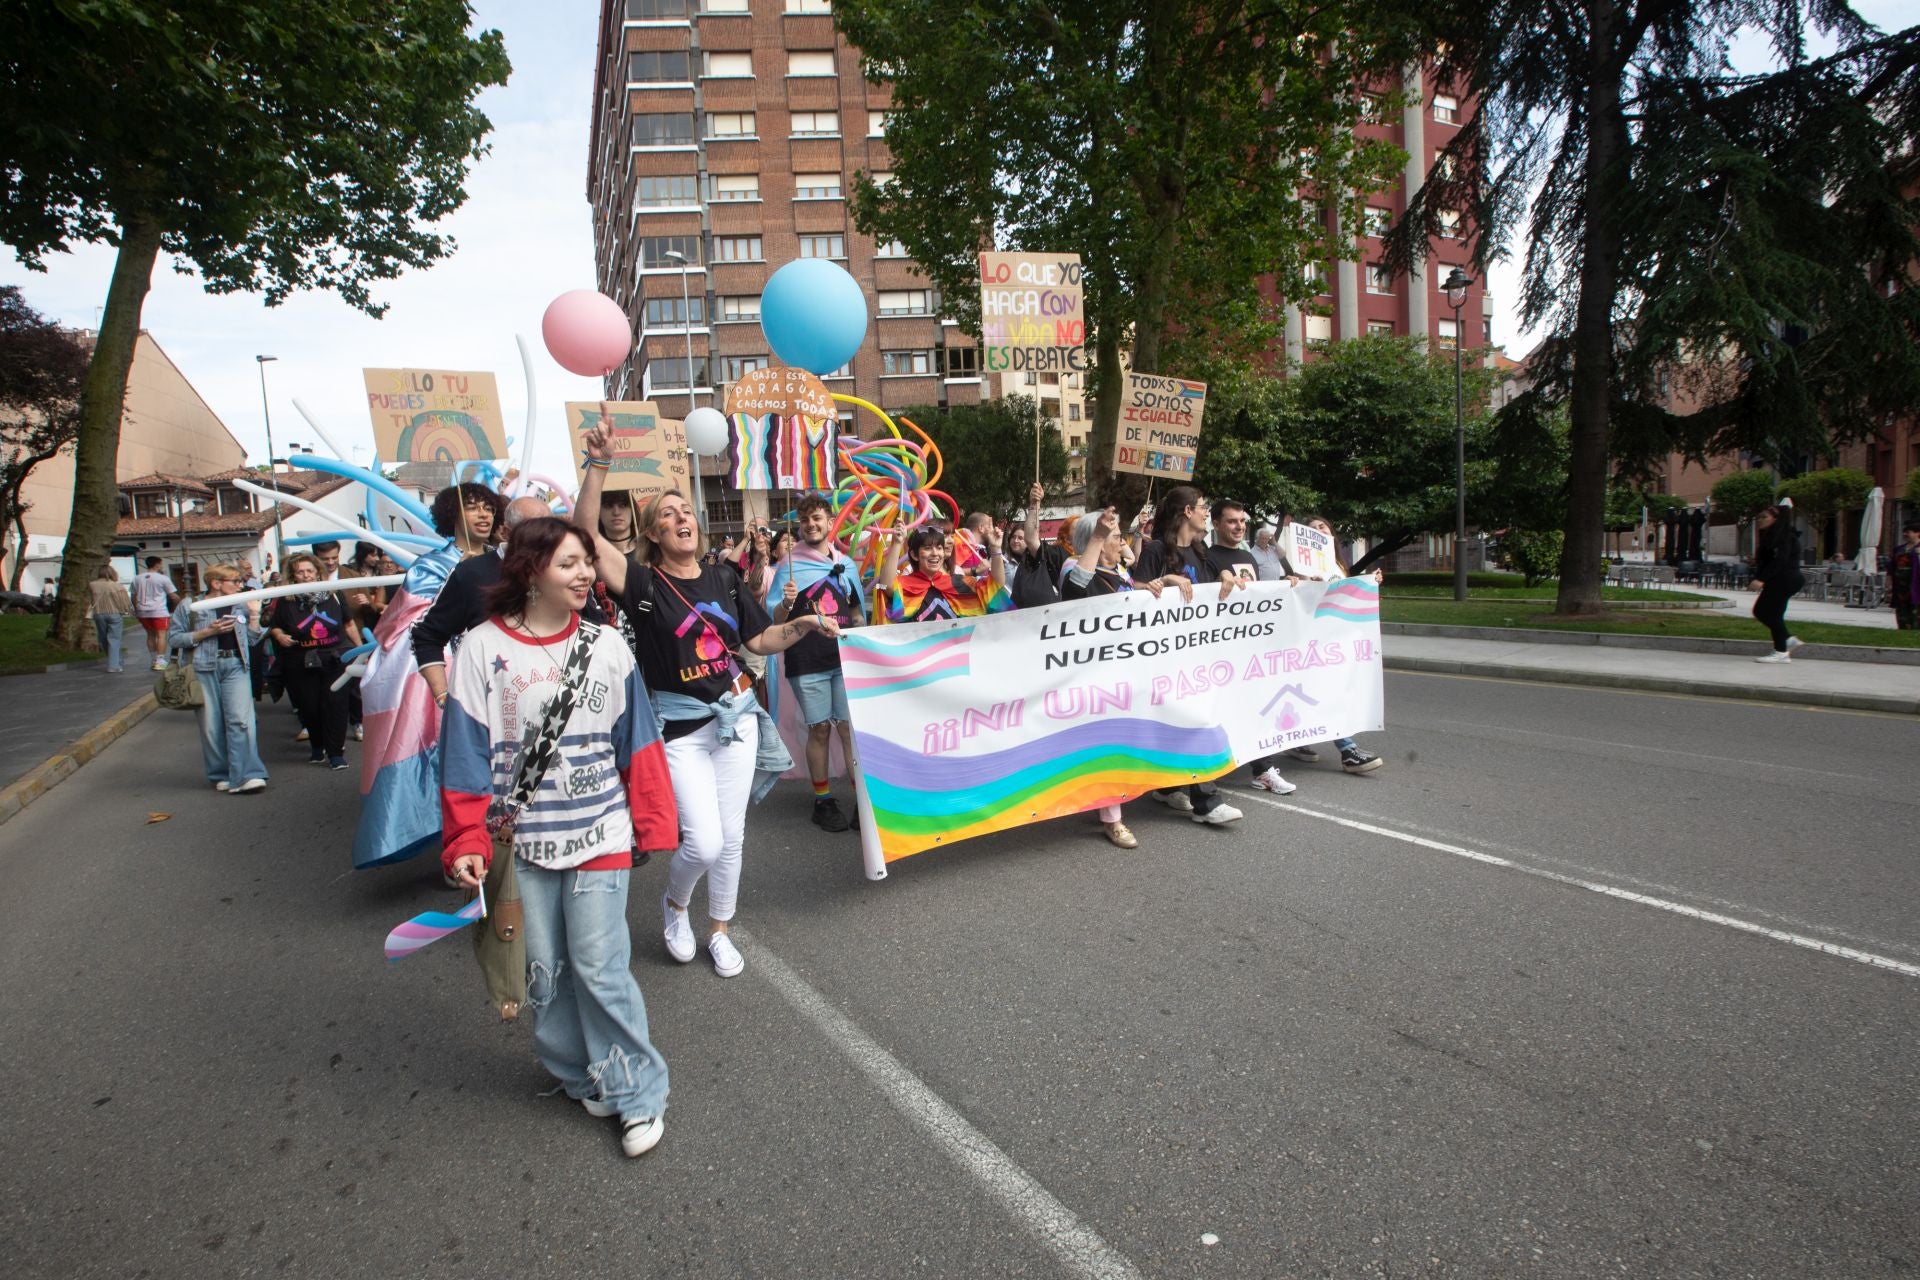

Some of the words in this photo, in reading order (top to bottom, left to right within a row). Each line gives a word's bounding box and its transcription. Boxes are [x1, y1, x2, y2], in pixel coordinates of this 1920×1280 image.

[1016, 262, 1057, 286] QUE
[1057, 262, 1081, 286] YO
[984, 290, 1040, 316] HAGA
[1040, 290, 1076, 315] CON
[1056, 319, 1084, 346] NO
[988, 346, 1010, 371] ES
[1012, 345, 1084, 371] DEBATE
[384, 372, 434, 393] SOLO
[442, 374, 469, 394] TU
[752, 371, 777, 381] BAJO
[786, 372, 807, 381] ESTE
[1129, 374, 1175, 393] TODXS
[368, 392, 425, 410] PUEDES
[735, 382, 825, 405] PARAGUAS
[1132, 391, 1193, 415] SOMOS
[736, 400, 787, 409] CABEMOS
[794, 399, 837, 419] TODAS
[1123, 407, 1193, 428] IGUALES
[1126, 427, 1141, 442] DE
[1149, 429, 1199, 450] MANERA
[1118, 446, 1195, 474] DIFERENTE
[1040, 604, 1209, 641] LLUCHANDO
[1215, 598, 1283, 617] POLOS
[1045, 638, 1170, 671] NUESOS
[1175, 622, 1275, 651] DERECHOS
[680, 663, 711, 682] LLAR
[1043, 682, 1133, 720] UN
[1150, 659, 1234, 706] PASO
[1242, 639, 1345, 681] ATRÁS
[1259, 734, 1285, 750] LLAR
[1286, 726, 1328, 743] TRANS
[562, 823, 606, 857] BACK
